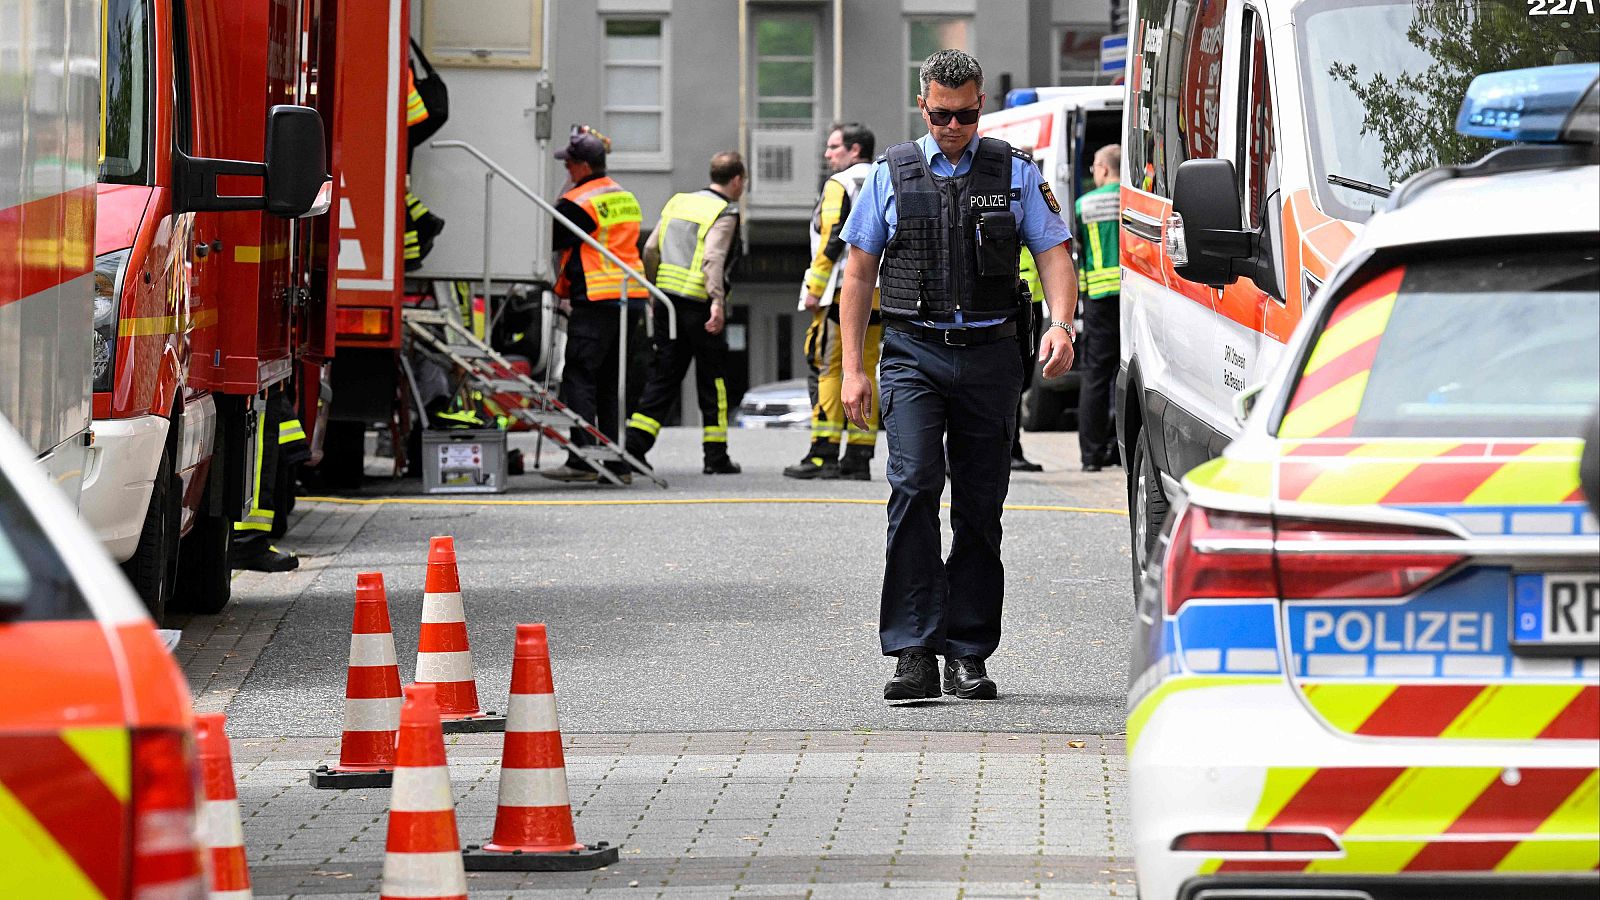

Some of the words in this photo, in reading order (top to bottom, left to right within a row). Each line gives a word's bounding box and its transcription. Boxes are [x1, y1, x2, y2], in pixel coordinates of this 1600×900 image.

[1527, 0, 1600, 15] 22/1
[970, 195, 1007, 208] POLIZEI
[1303, 610, 1494, 652] POLIZEI
[1521, 615, 1535, 632] D
